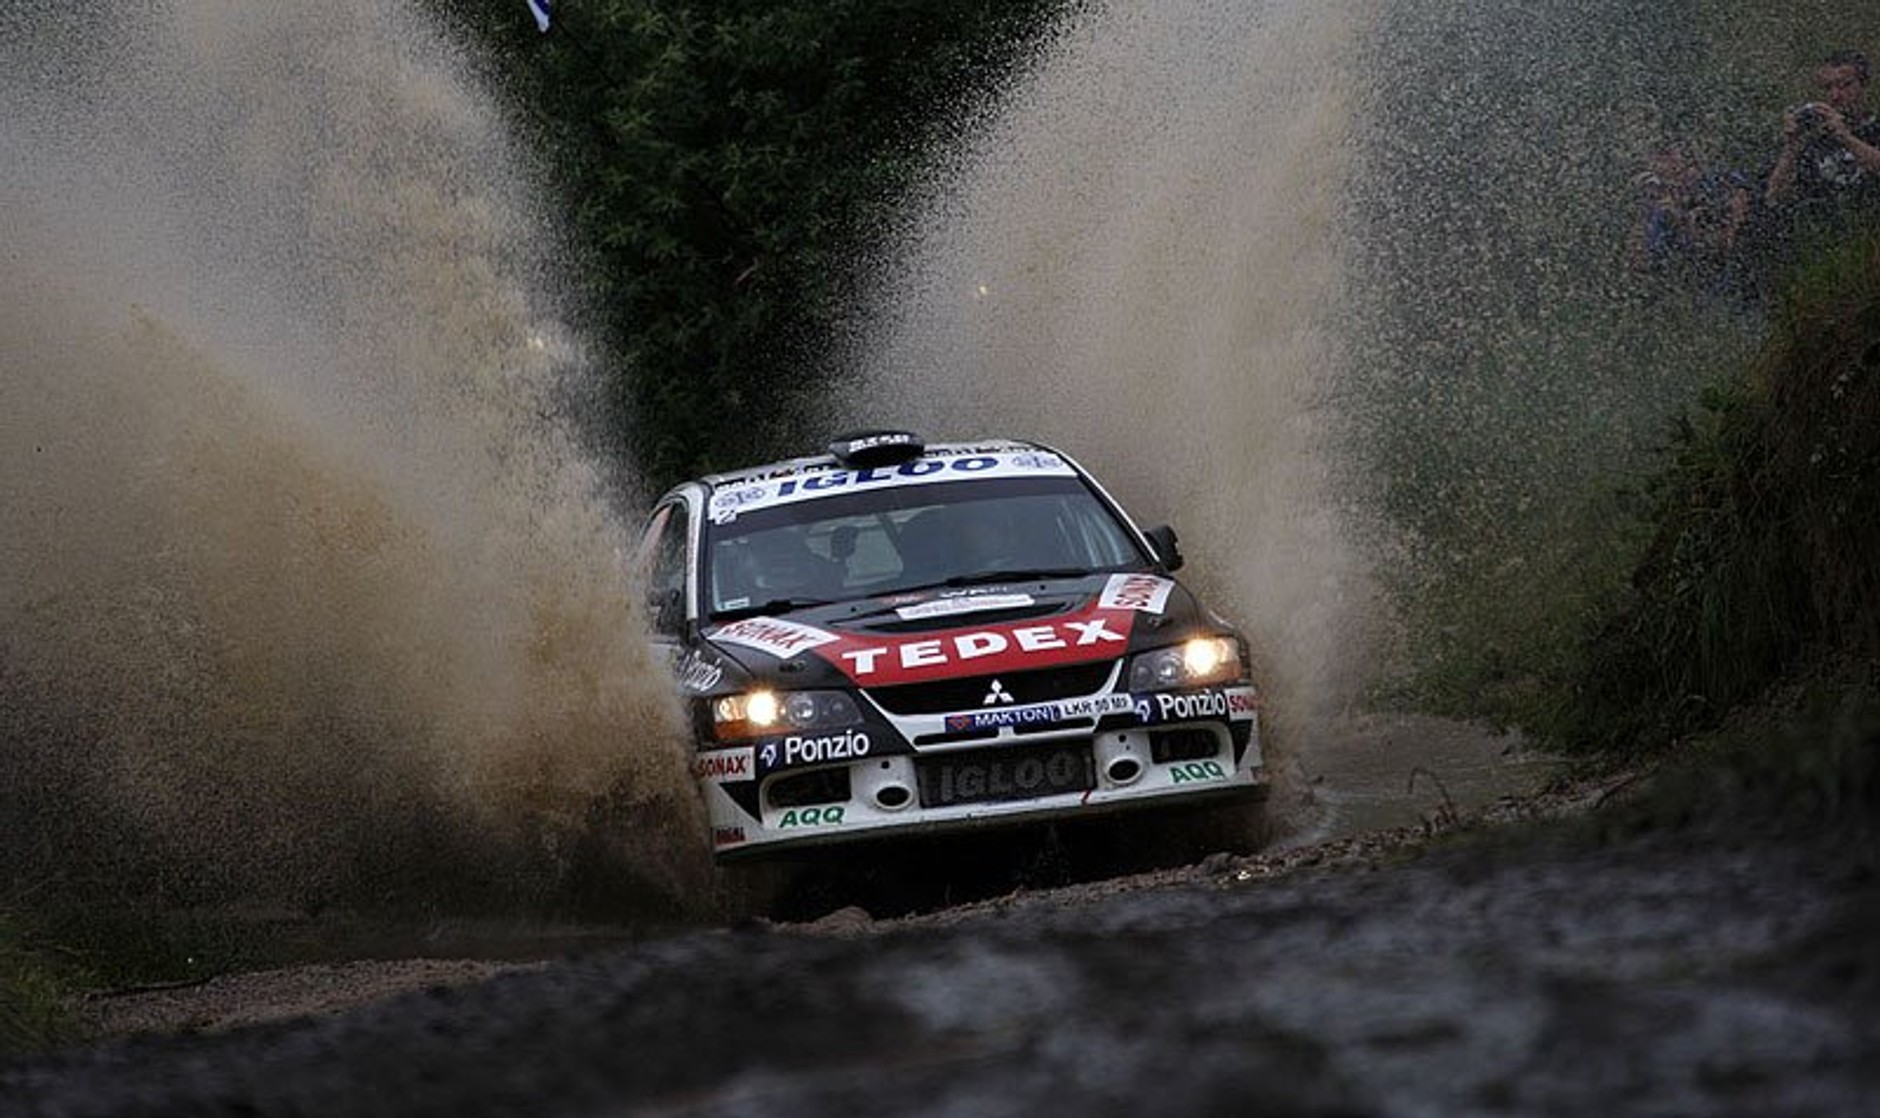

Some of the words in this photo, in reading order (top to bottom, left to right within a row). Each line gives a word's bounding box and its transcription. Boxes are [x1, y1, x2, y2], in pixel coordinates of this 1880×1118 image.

[777, 457, 999, 497] IGLOO
[841, 618, 1127, 675] TEDEX
[974, 706, 1048, 727] MAKTON
[1156, 688, 1226, 720] Ponzio
[784, 729, 870, 764] Ponzio
[697, 755, 746, 778] SONAX
[941, 751, 1075, 801] IGLOO
[1169, 760, 1225, 784] AQQ
[779, 806, 846, 829] AQQ
